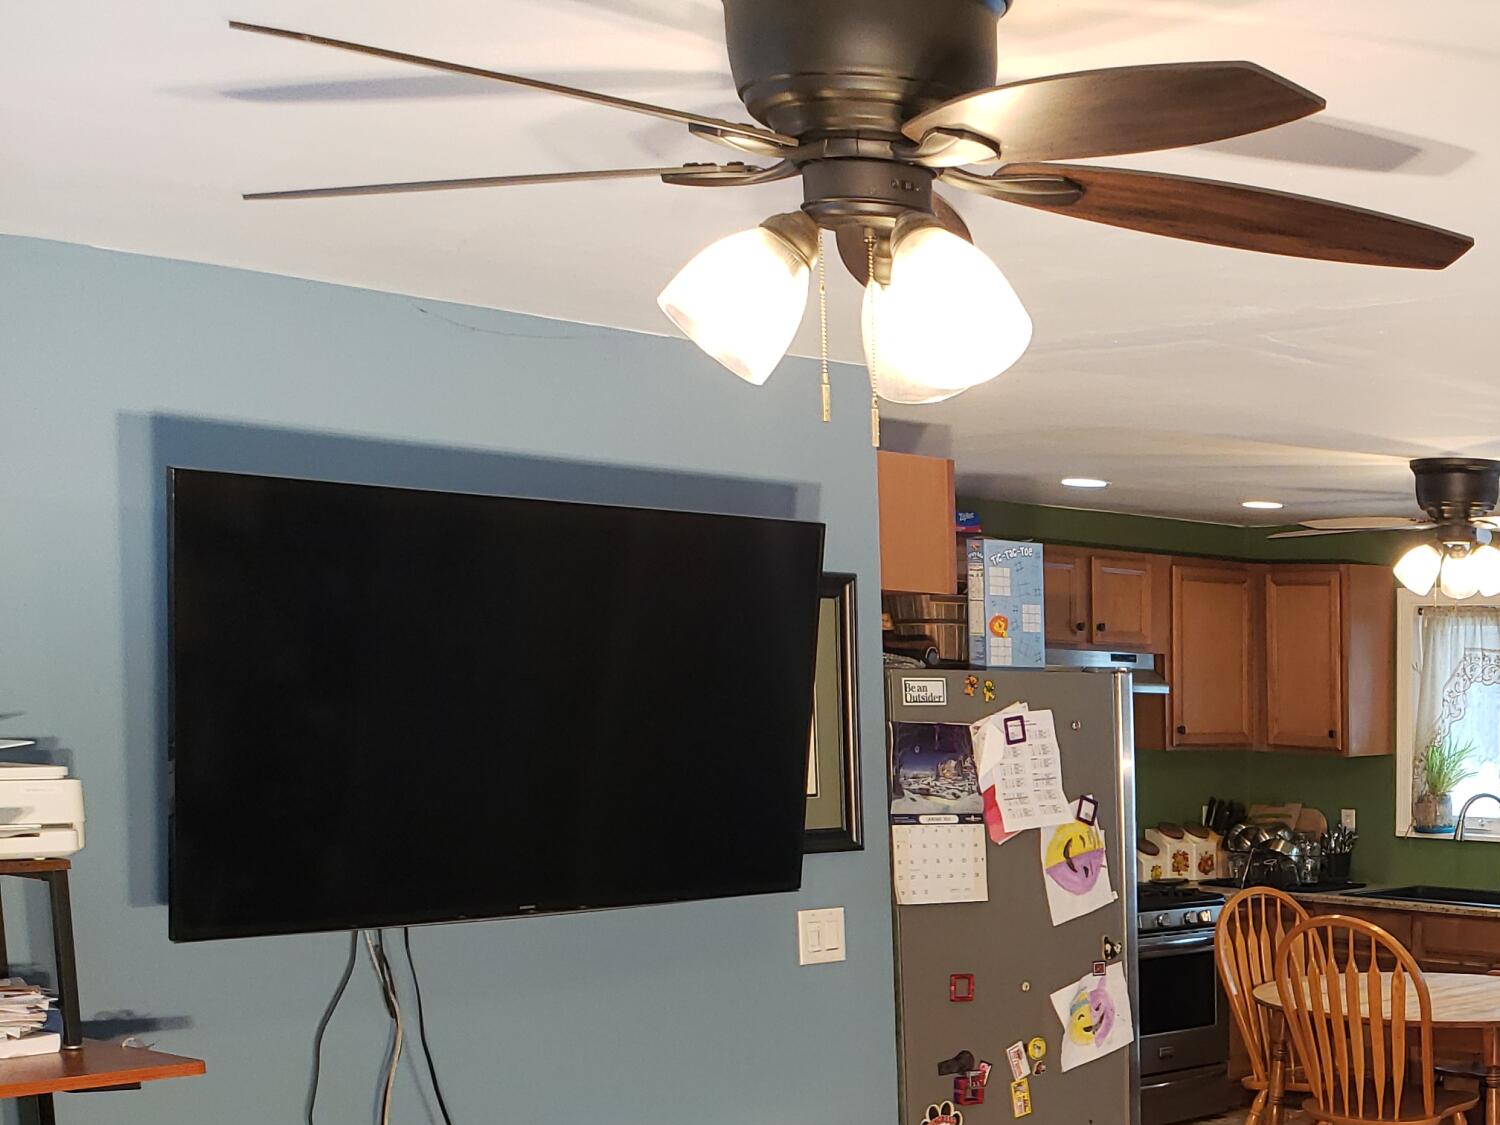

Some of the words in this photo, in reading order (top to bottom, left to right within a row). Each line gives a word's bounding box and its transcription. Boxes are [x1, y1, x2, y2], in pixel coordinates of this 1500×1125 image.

[958, 512, 975, 521] Ziploc
[905, 683, 916, 692] Be
[905, 692, 943, 703] Outsider
